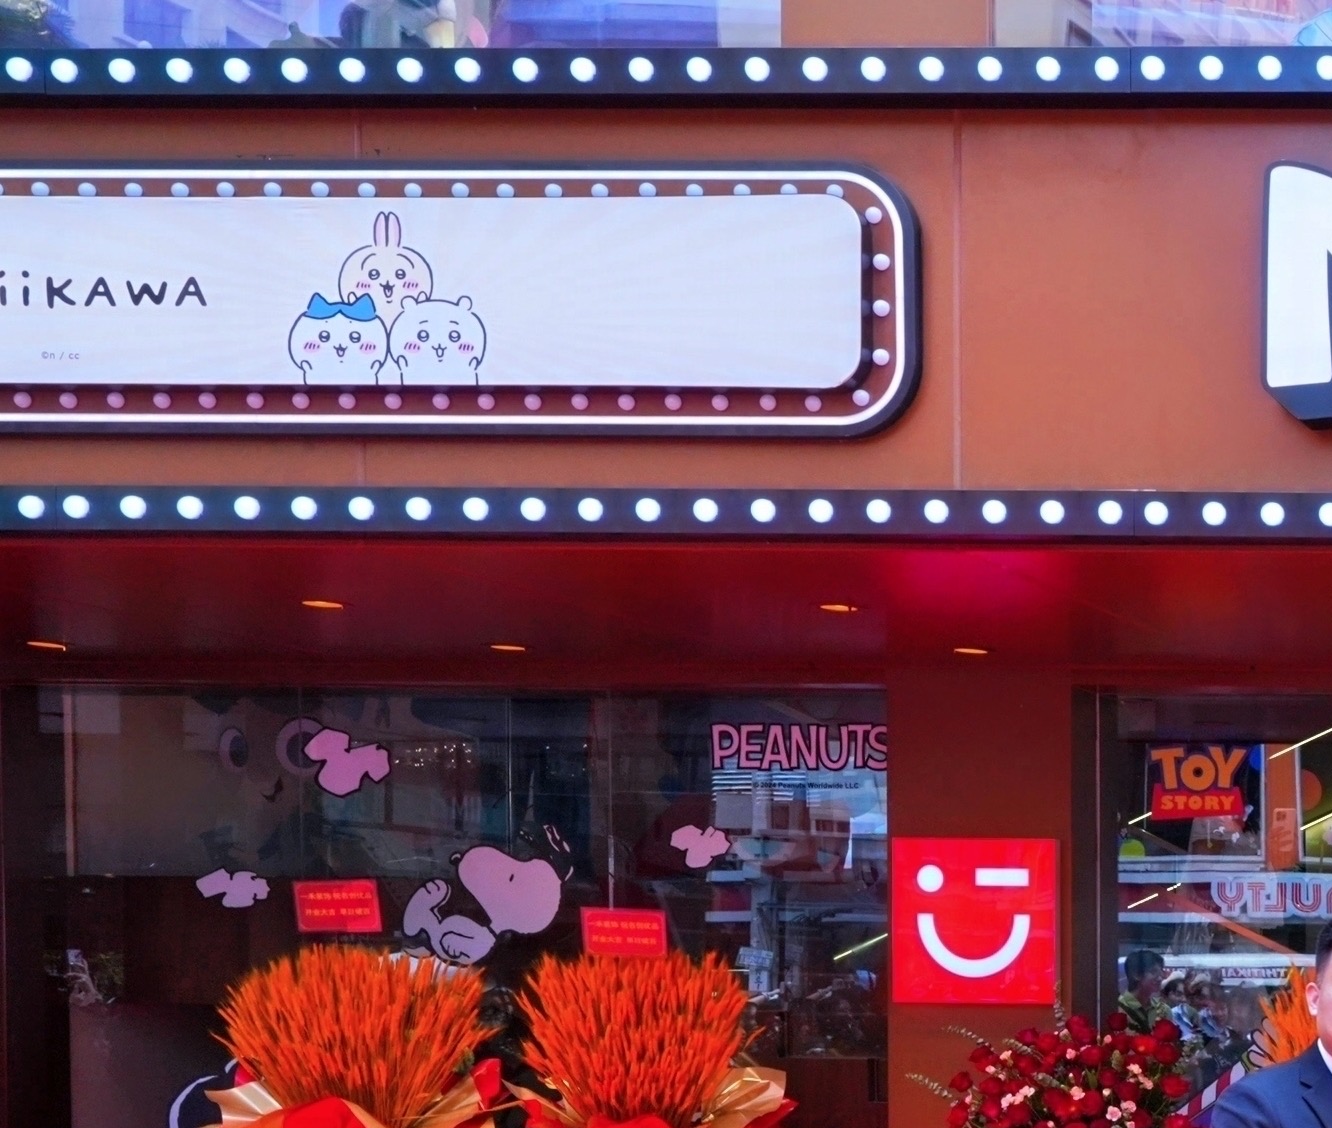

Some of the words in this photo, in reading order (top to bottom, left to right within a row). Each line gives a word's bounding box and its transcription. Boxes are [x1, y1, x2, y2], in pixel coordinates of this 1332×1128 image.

[711, 723, 887, 771] PEANUTS
[1150, 745, 1247, 791] TOY
[1160, 795, 1235, 810] STORY
